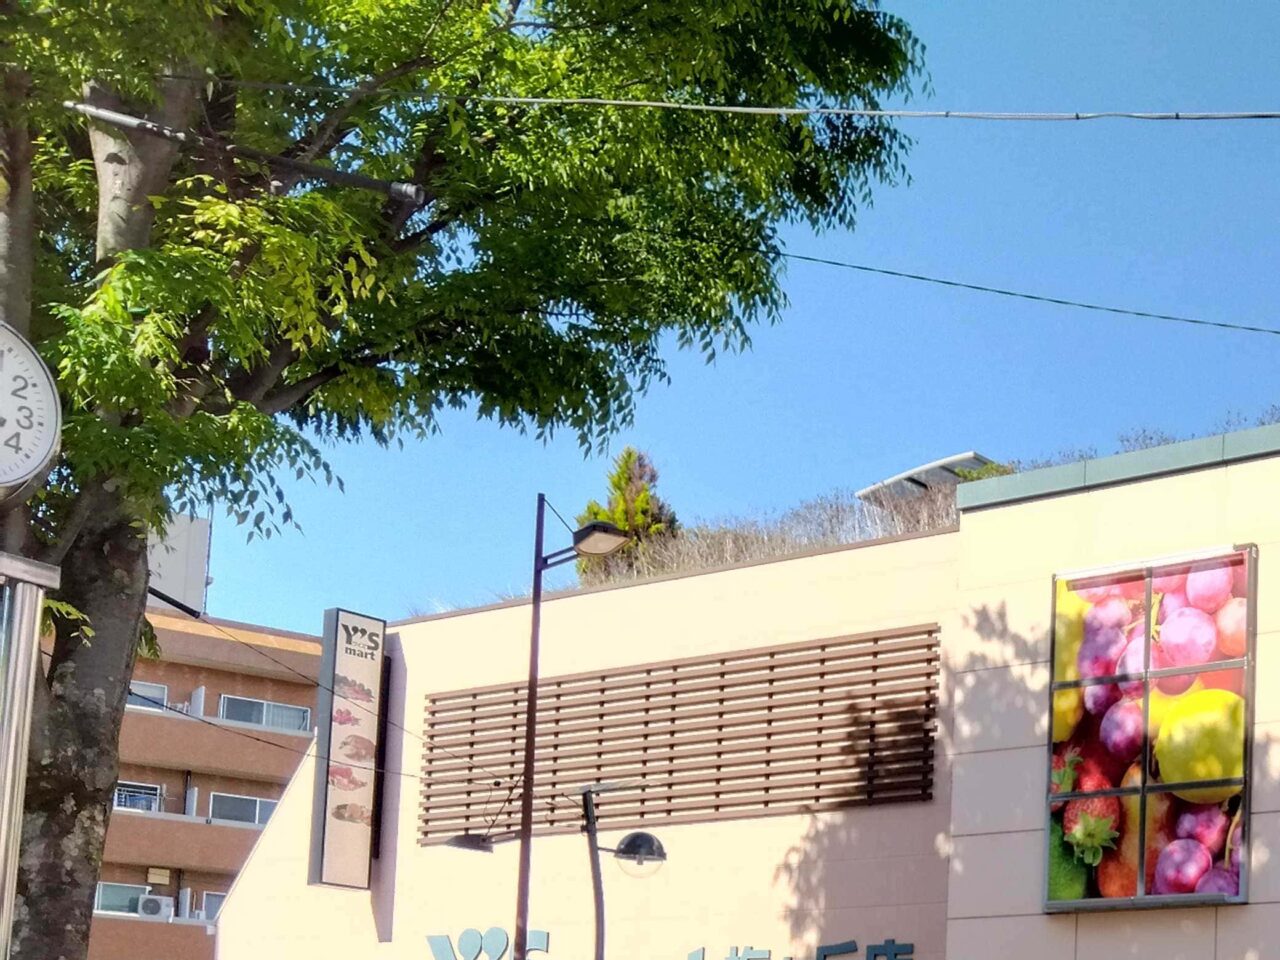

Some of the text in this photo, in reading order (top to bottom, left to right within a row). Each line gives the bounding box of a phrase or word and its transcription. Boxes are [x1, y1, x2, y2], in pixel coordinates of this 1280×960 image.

[11, 375, 28, 400] 2
[16, 406, 34, 430] 3
[4, 432, 22, 454] 4
[345, 646, 376, 661] mart
